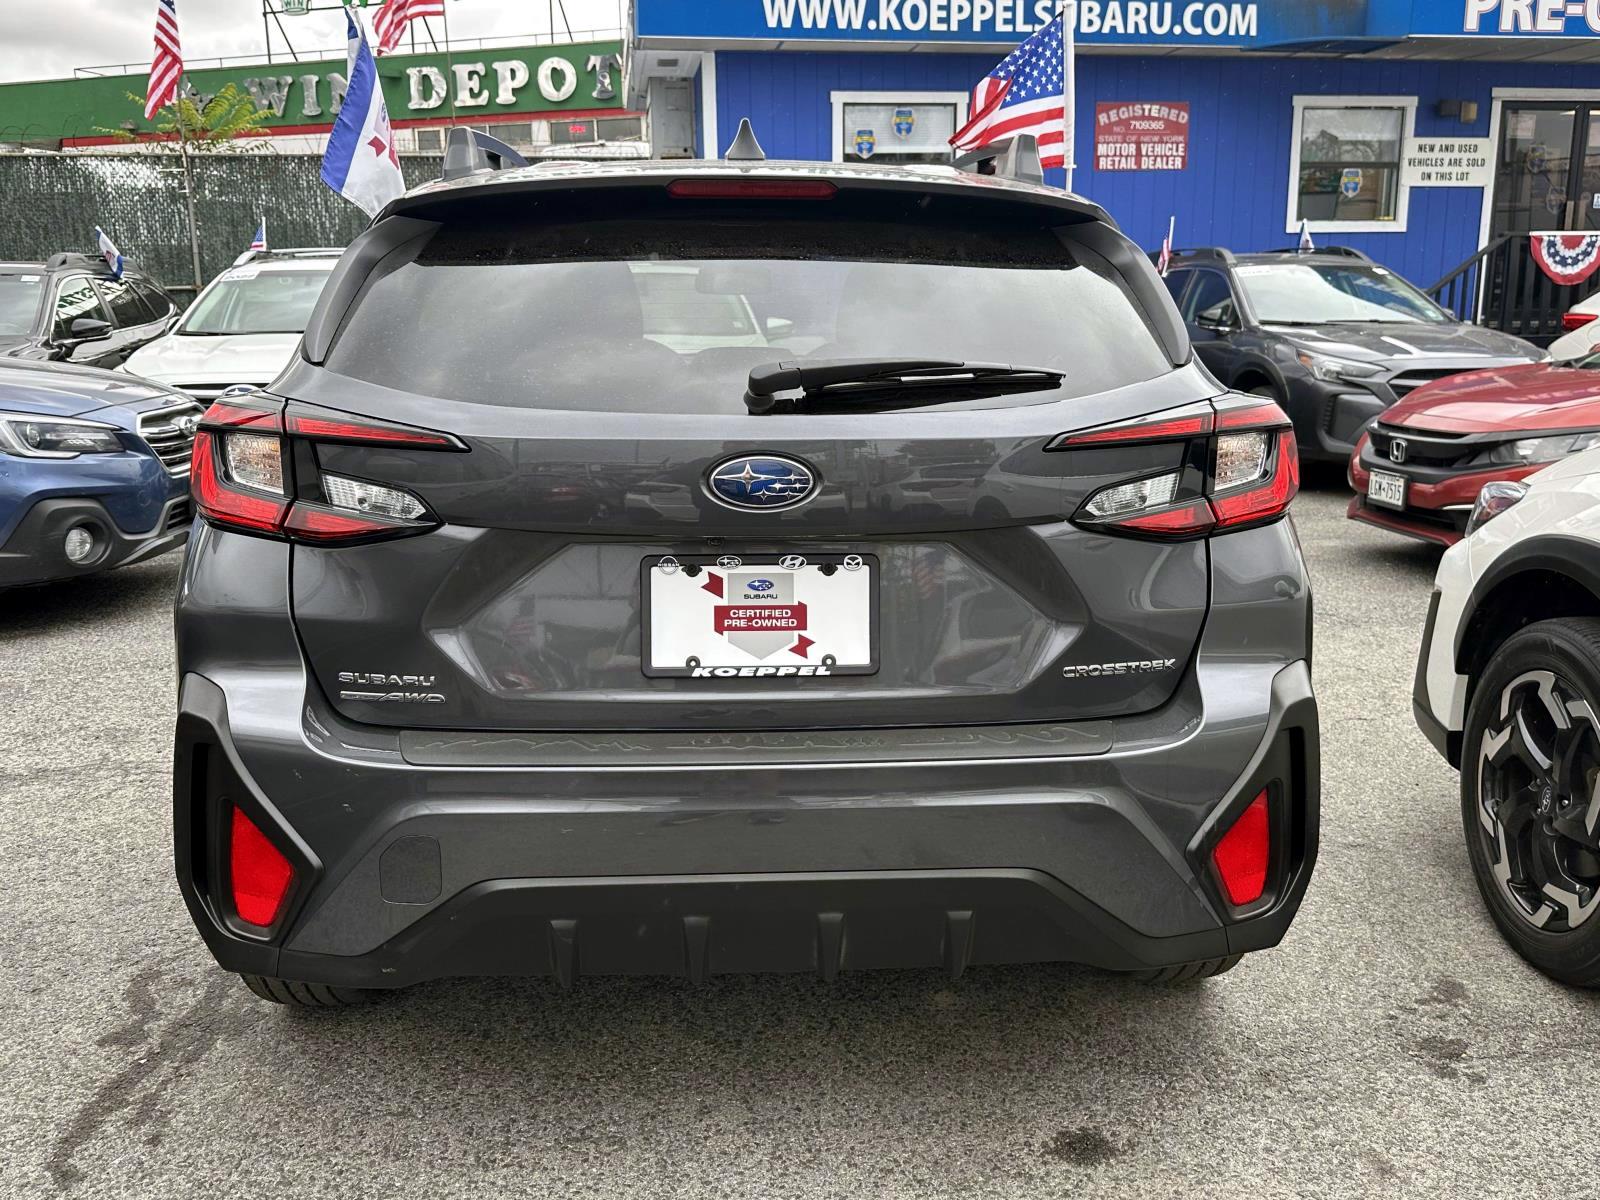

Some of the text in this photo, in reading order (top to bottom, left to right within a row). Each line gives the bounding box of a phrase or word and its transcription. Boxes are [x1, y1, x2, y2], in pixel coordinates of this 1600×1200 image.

[1464, 0, 1600, 32] PRE-
[406, 53, 623, 110] DEPOT
[1098, 104, 1189, 126] REGISTERED
[1129, 120, 1165, 130] 7109365
[1098, 135, 1185, 143] STATE OF NEW YORK
[1097, 143, 1185, 156] MOTOR VEHICLE
[1417, 144, 1478, 153] NEW AND USED
[1099, 157, 1182, 170] RETAIL DEALER
[1408, 157, 1486, 167] VEHICLES ARE SOLD
[1420, 172, 1470, 181] ON THIS LOT
[729, 609, 791, 618] CERTIFIED
[724, 618, 797, 627] PRE-OWNED
[692, 666, 831, 678] KOEPPEL
[1063, 658, 1176, 678] CROSSTREK
[338, 671, 436, 687] SUBARU
[378, 692, 446, 704] AWD
